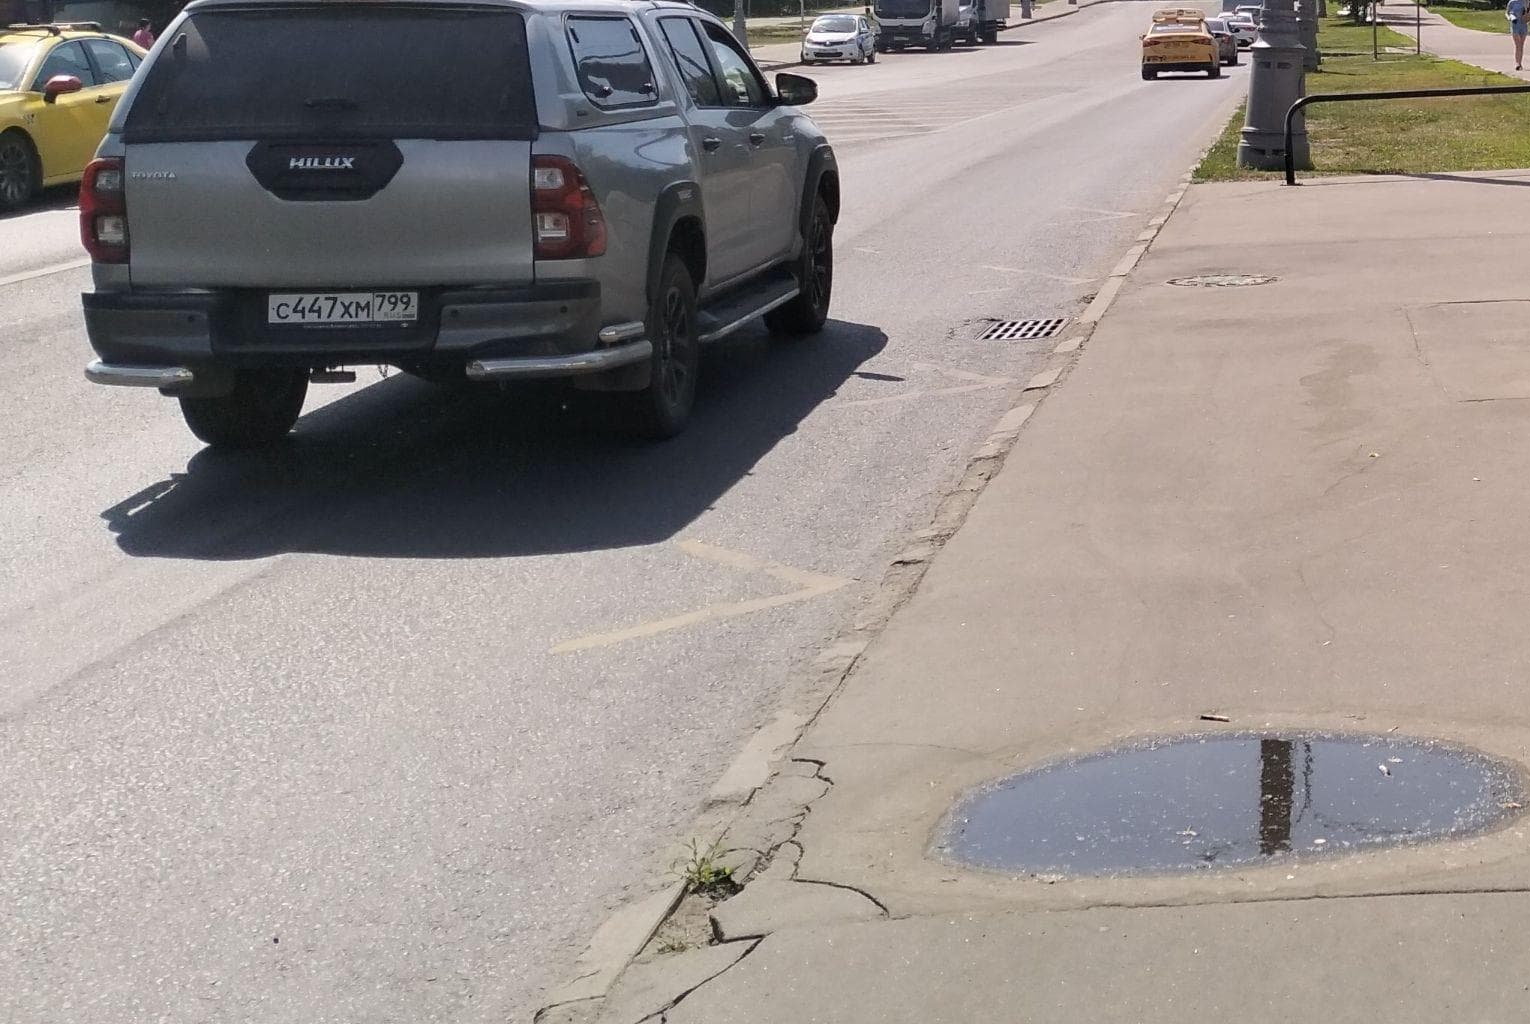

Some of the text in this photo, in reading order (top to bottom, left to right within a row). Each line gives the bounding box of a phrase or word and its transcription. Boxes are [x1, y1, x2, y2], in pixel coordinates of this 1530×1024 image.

[289, 157, 355, 169] HILUX
[132, 171, 177, 179] TOYOTA
[376, 293, 411, 312] 799
